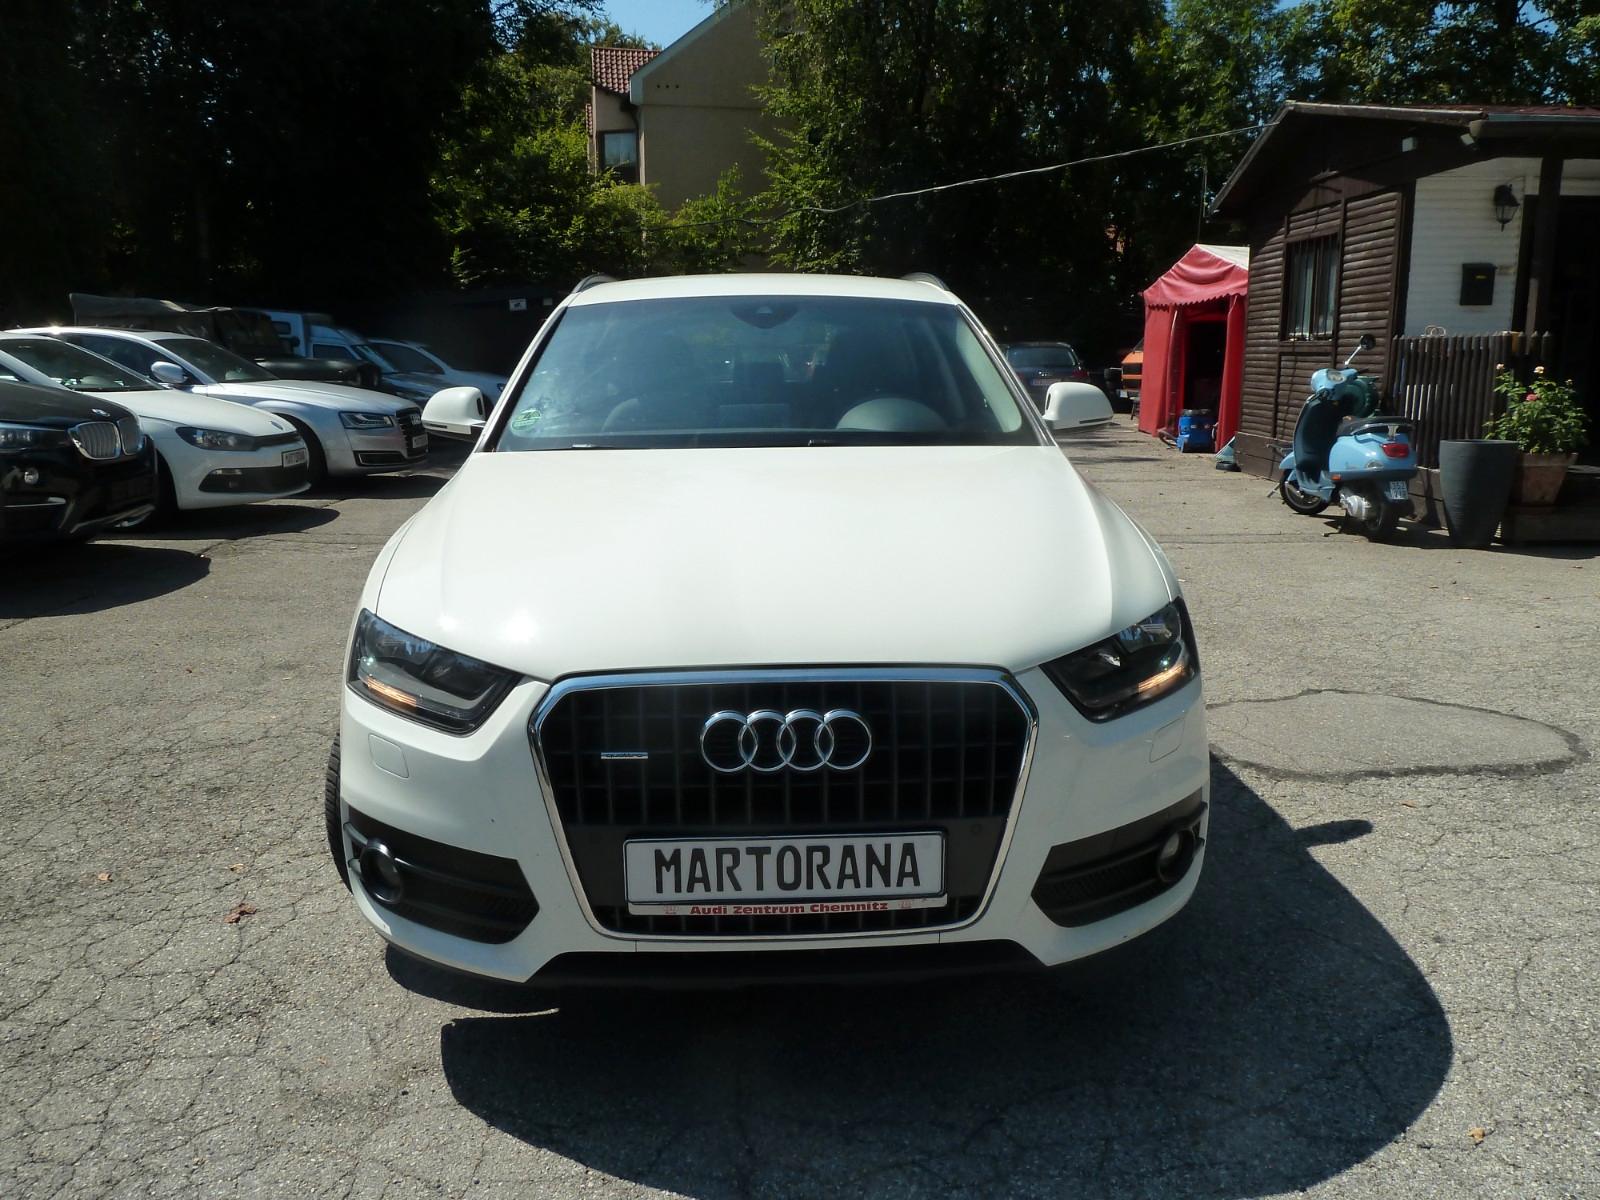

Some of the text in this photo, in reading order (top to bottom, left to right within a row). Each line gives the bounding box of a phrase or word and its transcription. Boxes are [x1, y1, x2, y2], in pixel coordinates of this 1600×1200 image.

[654, 842, 921, 894] MARTORANA
[690, 904, 727, 915] Audi
[732, 904, 805, 914] Zentrum
[810, 901, 889, 913] Chemnitz
